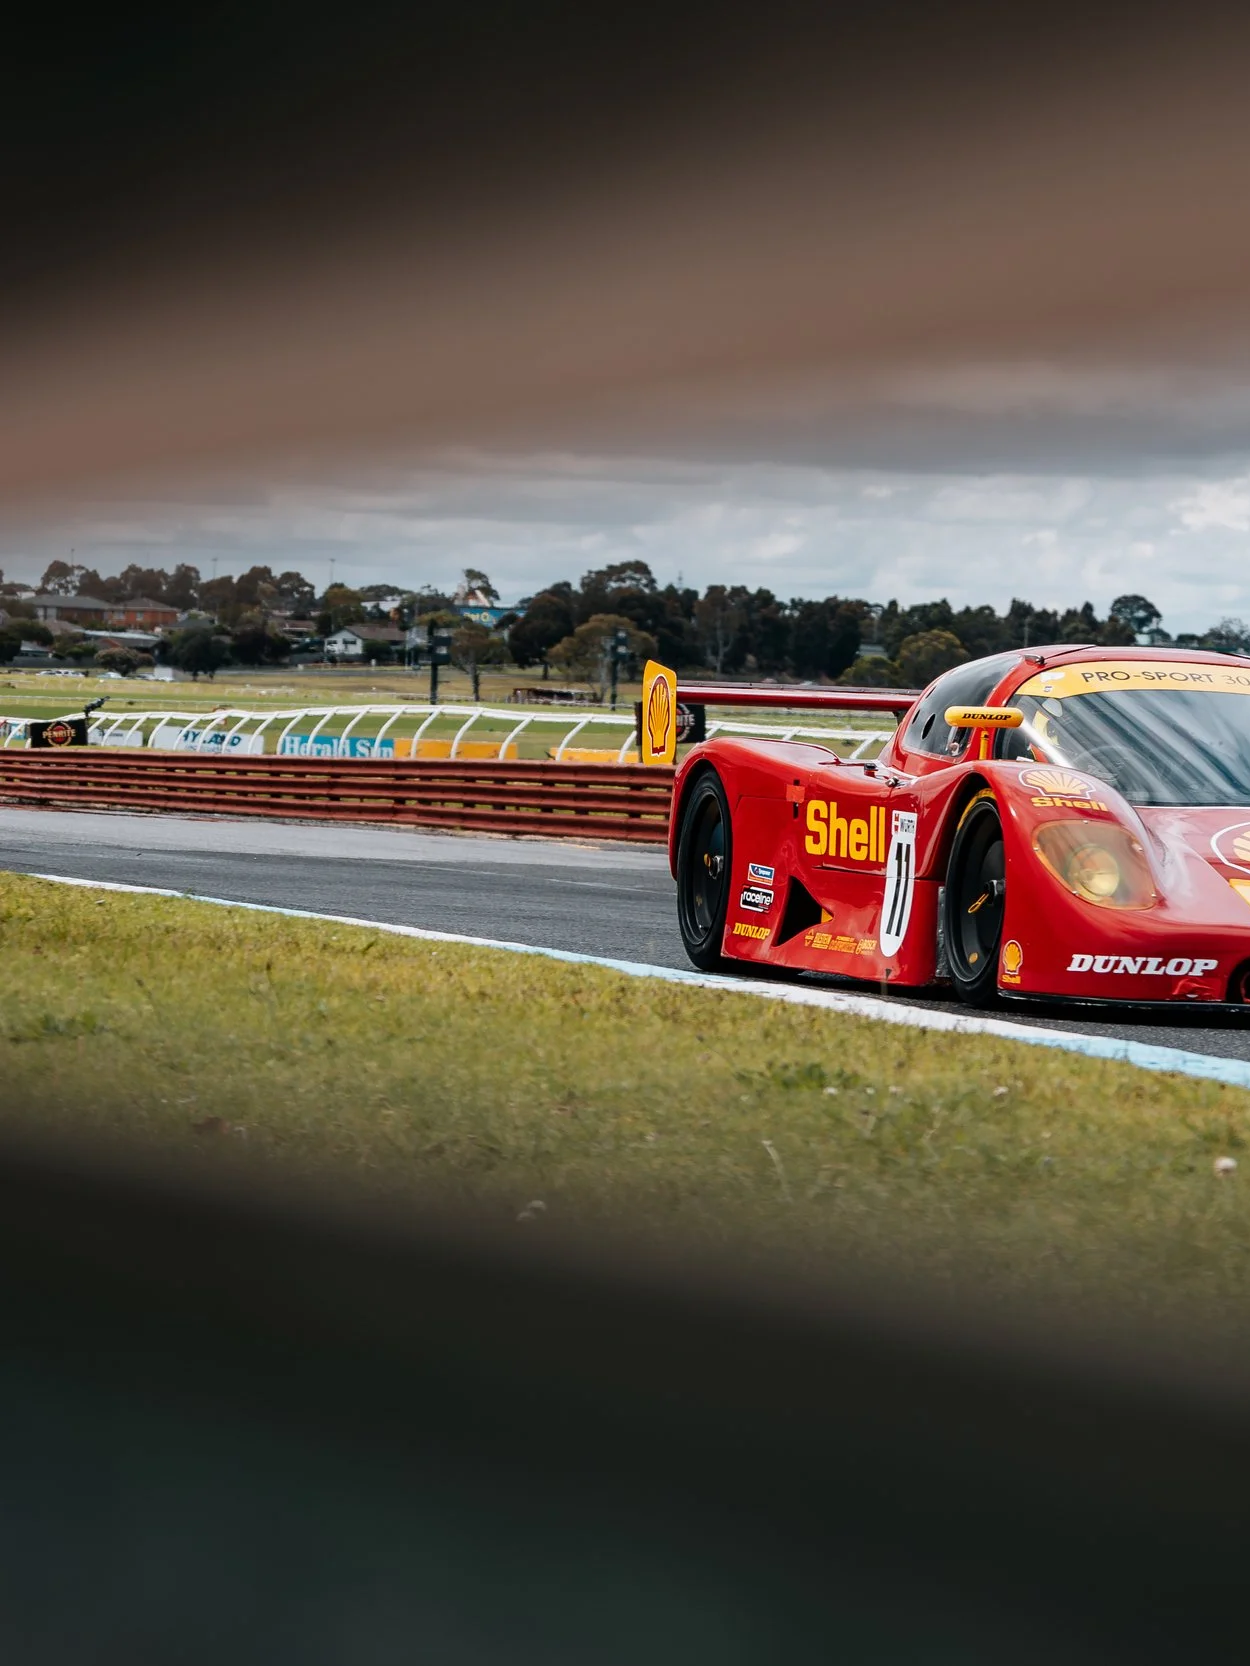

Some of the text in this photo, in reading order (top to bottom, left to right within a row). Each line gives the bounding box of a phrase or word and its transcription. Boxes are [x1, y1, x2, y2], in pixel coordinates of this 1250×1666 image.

[1081, 670, 1215, 684] PRO-SPORT
[962, 712, 1012, 721] DUNLOP
[42, 728, 76, 739] PENRITE
[1031, 796, 1109, 811] Shell
[805, 800, 886, 863] Shell
[885, 842, 911, 937] 11
[742, 891, 771, 906] raceline
[733, 922, 771, 940] DUNLOP
[1066, 953, 1218, 977] DUNLOP
[1001, 974, 1021, 984] Shell
